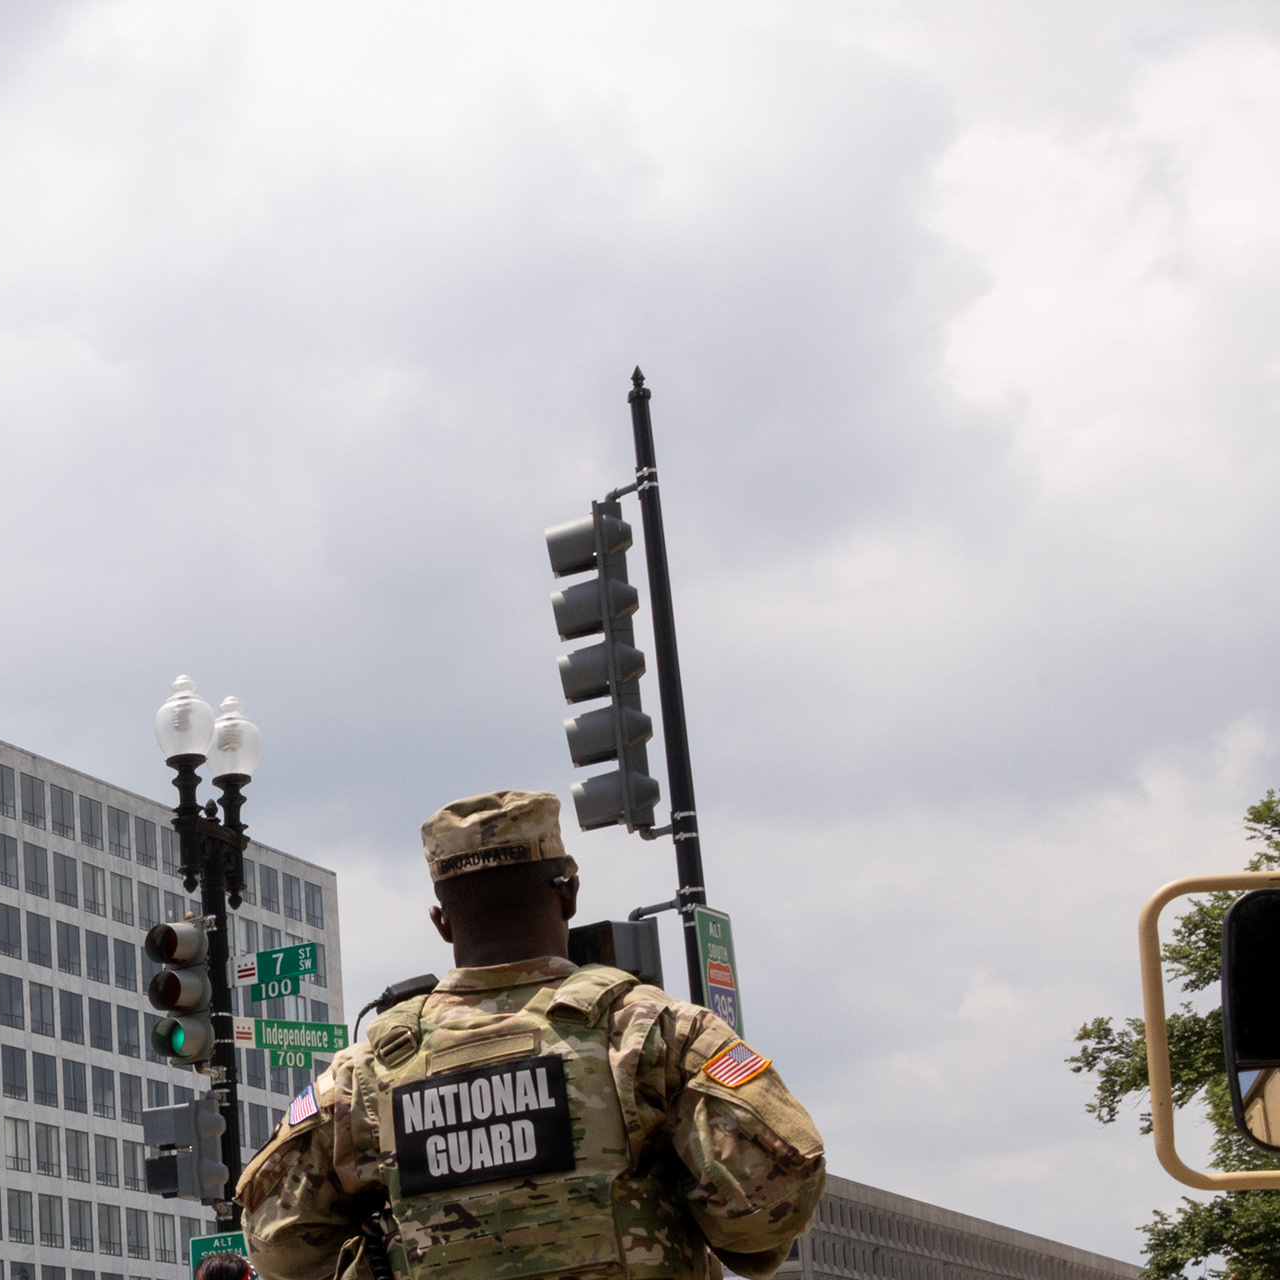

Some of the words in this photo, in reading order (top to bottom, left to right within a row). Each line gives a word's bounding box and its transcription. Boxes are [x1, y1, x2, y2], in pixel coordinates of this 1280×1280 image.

[440, 845, 526, 874] BROADWATER
[708, 921, 721, 938] ALT
[299, 947, 311, 959] ST
[708, 943, 728, 961] SOUTH
[272, 953, 284, 975] 7
[299, 959, 312, 971] SW
[260, 978, 292, 999] 100
[714, 994, 735, 1027] 395
[262, 1022, 328, 1050] Independence
[334, 1026, 343, 1037] Ave
[334, 1038, 344, 1049] SW
[277, 1051, 305, 1067] 700
[402, 1067, 556, 1133] NATIONAL
[425, 1122, 538, 1178] GUARD
[213, 1237, 232, 1247] ALT
